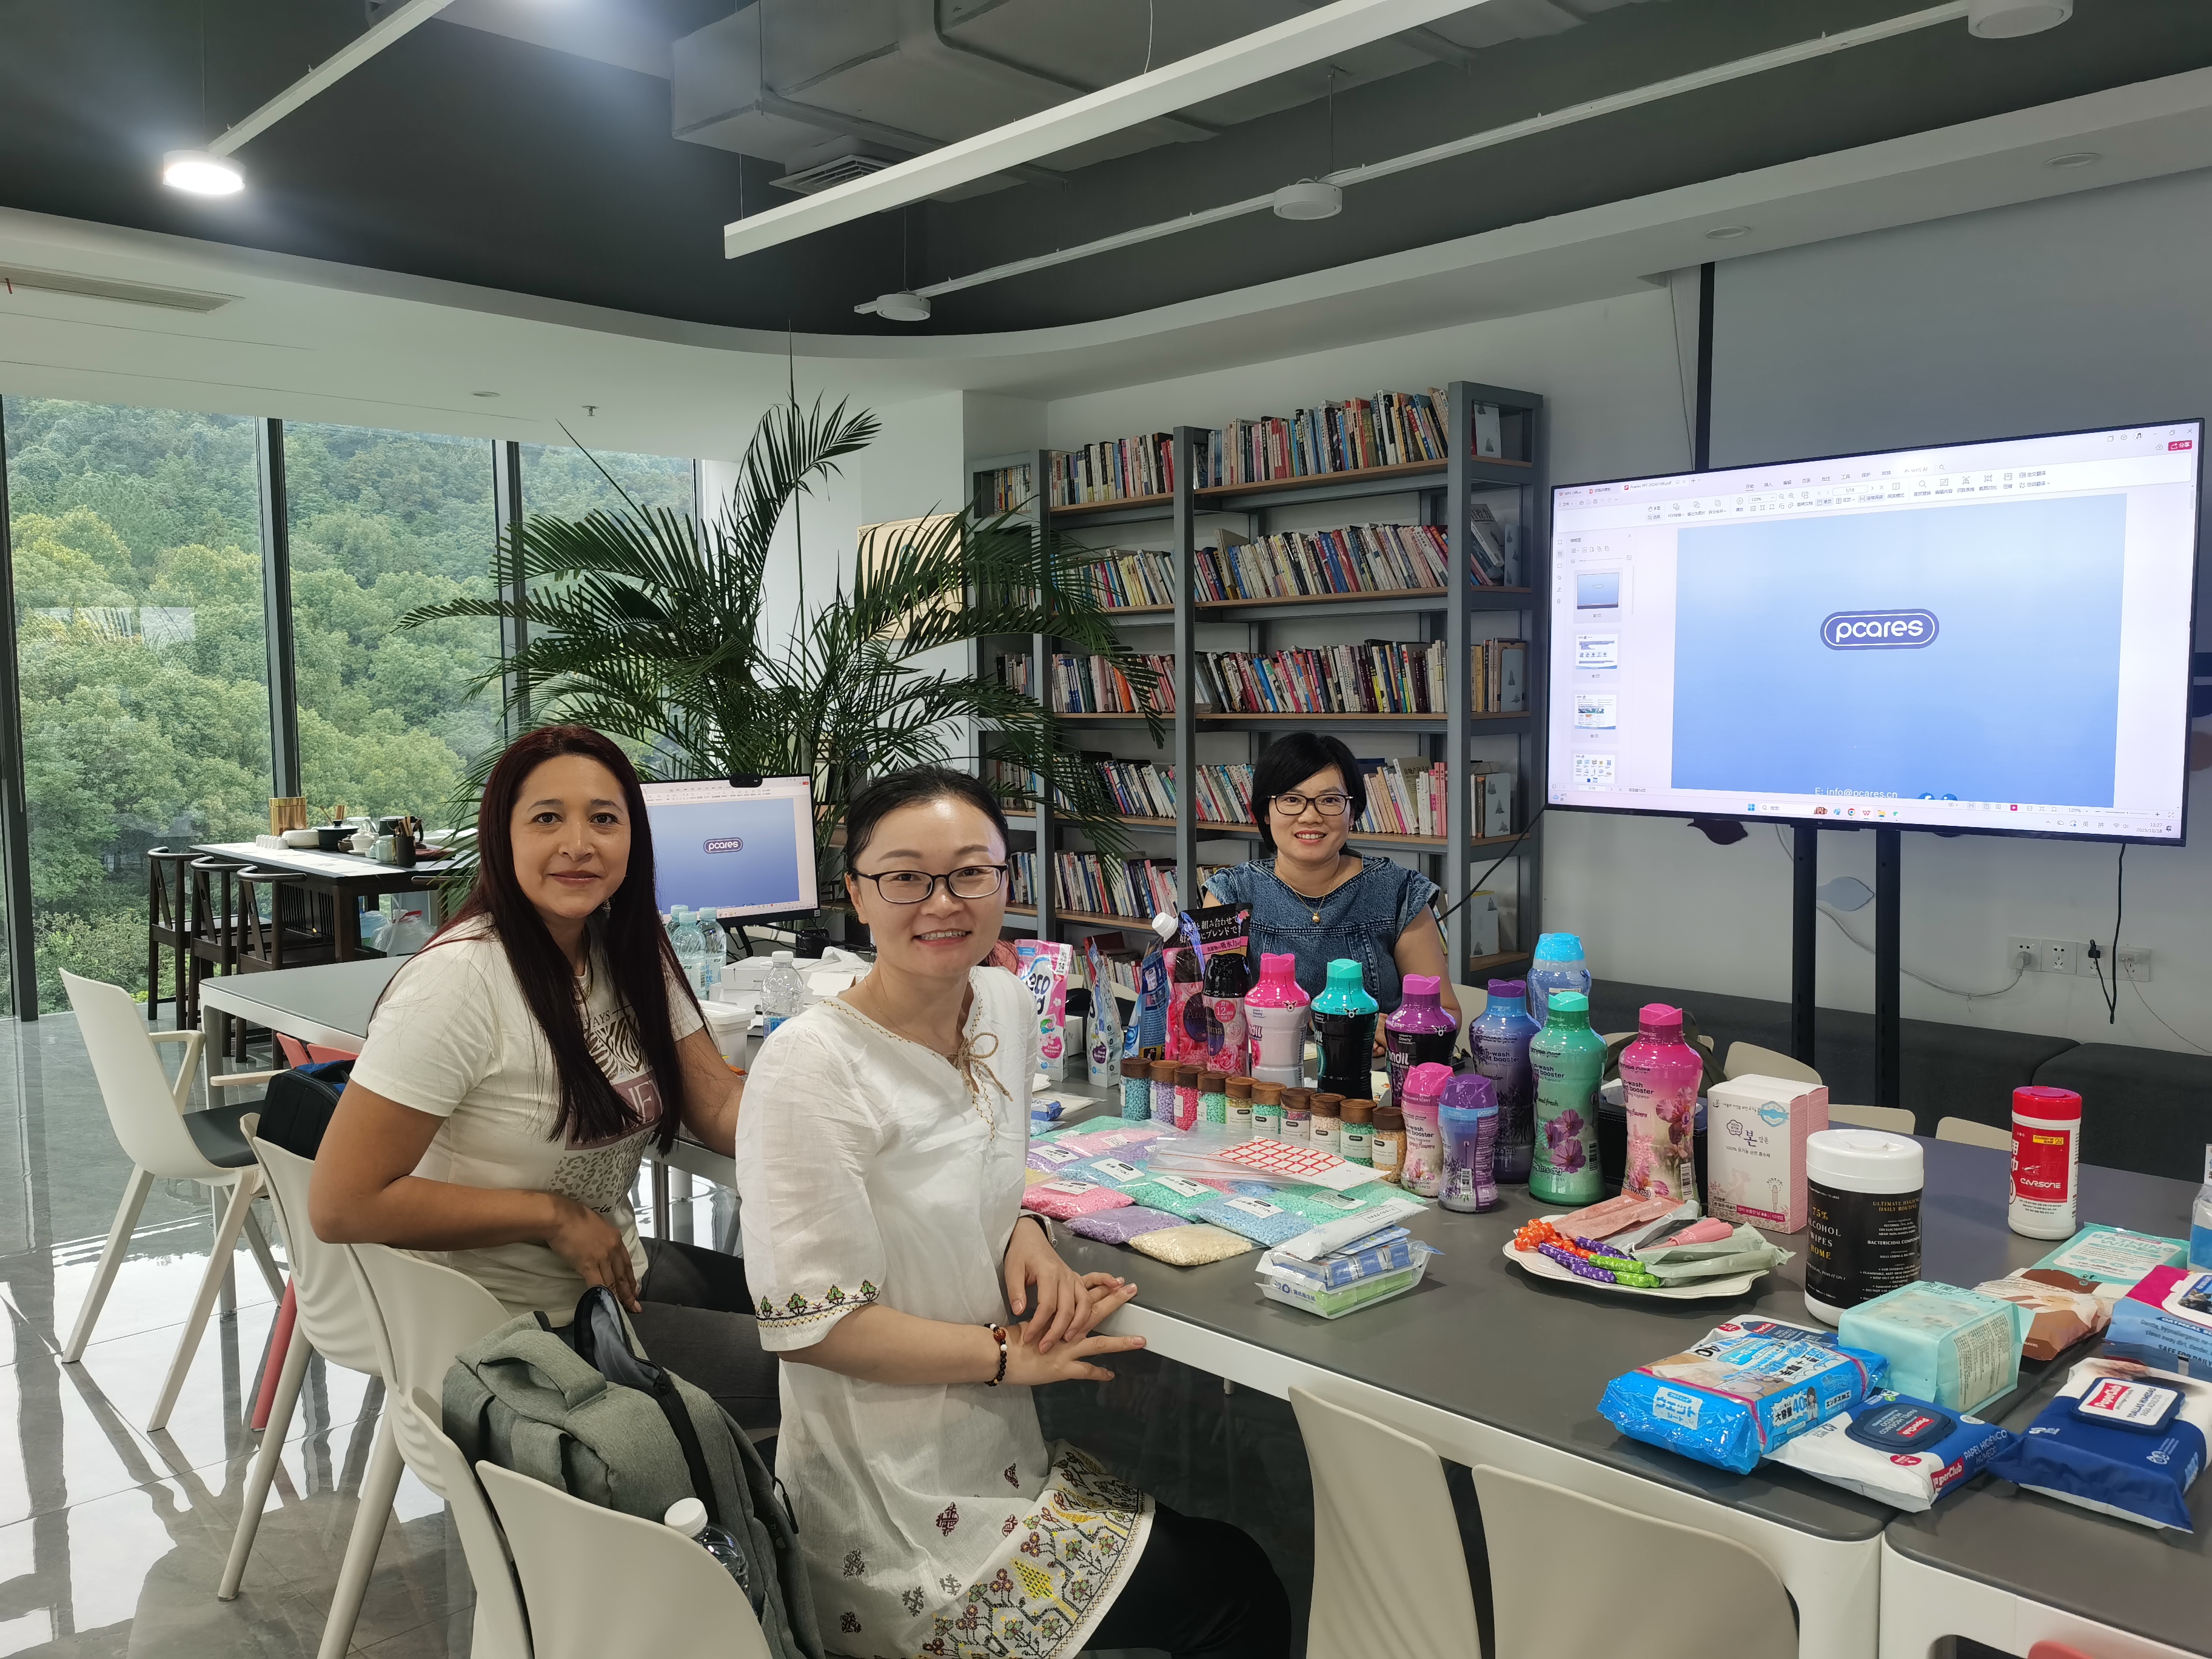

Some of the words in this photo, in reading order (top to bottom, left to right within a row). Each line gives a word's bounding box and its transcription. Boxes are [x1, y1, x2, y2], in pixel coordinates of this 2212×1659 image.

[1835, 617, 1925, 643] pcares
[1815, 787, 1823, 796] E:
[1826, 788, 1898, 799] info@pcares.cn
[708, 841, 739, 851] pcares
[1216, 1007, 1226, 1016] 12
[1540, 1070, 1565, 1079] booster
[1629, 1086, 1654, 1094] booster
[1743, 1130, 1757, 1147] 본
[1812, 1207, 1828, 1221] 75%
[1810, 1231, 1832, 1247] WIPES
[2092, 1233, 2177, 1253] BATHING
[1811, 1244, 1831, 1260] HOME
[2158, 1344, 2176, 1355] SAFE
[2094, 1384, 2122, 1409] PaperClub
[1793, 1396, 1806, 1413] 40
[1963, 1446, 1980, 1460] PAPEL
[1932, 1464, 1962, 1487] PperClub
